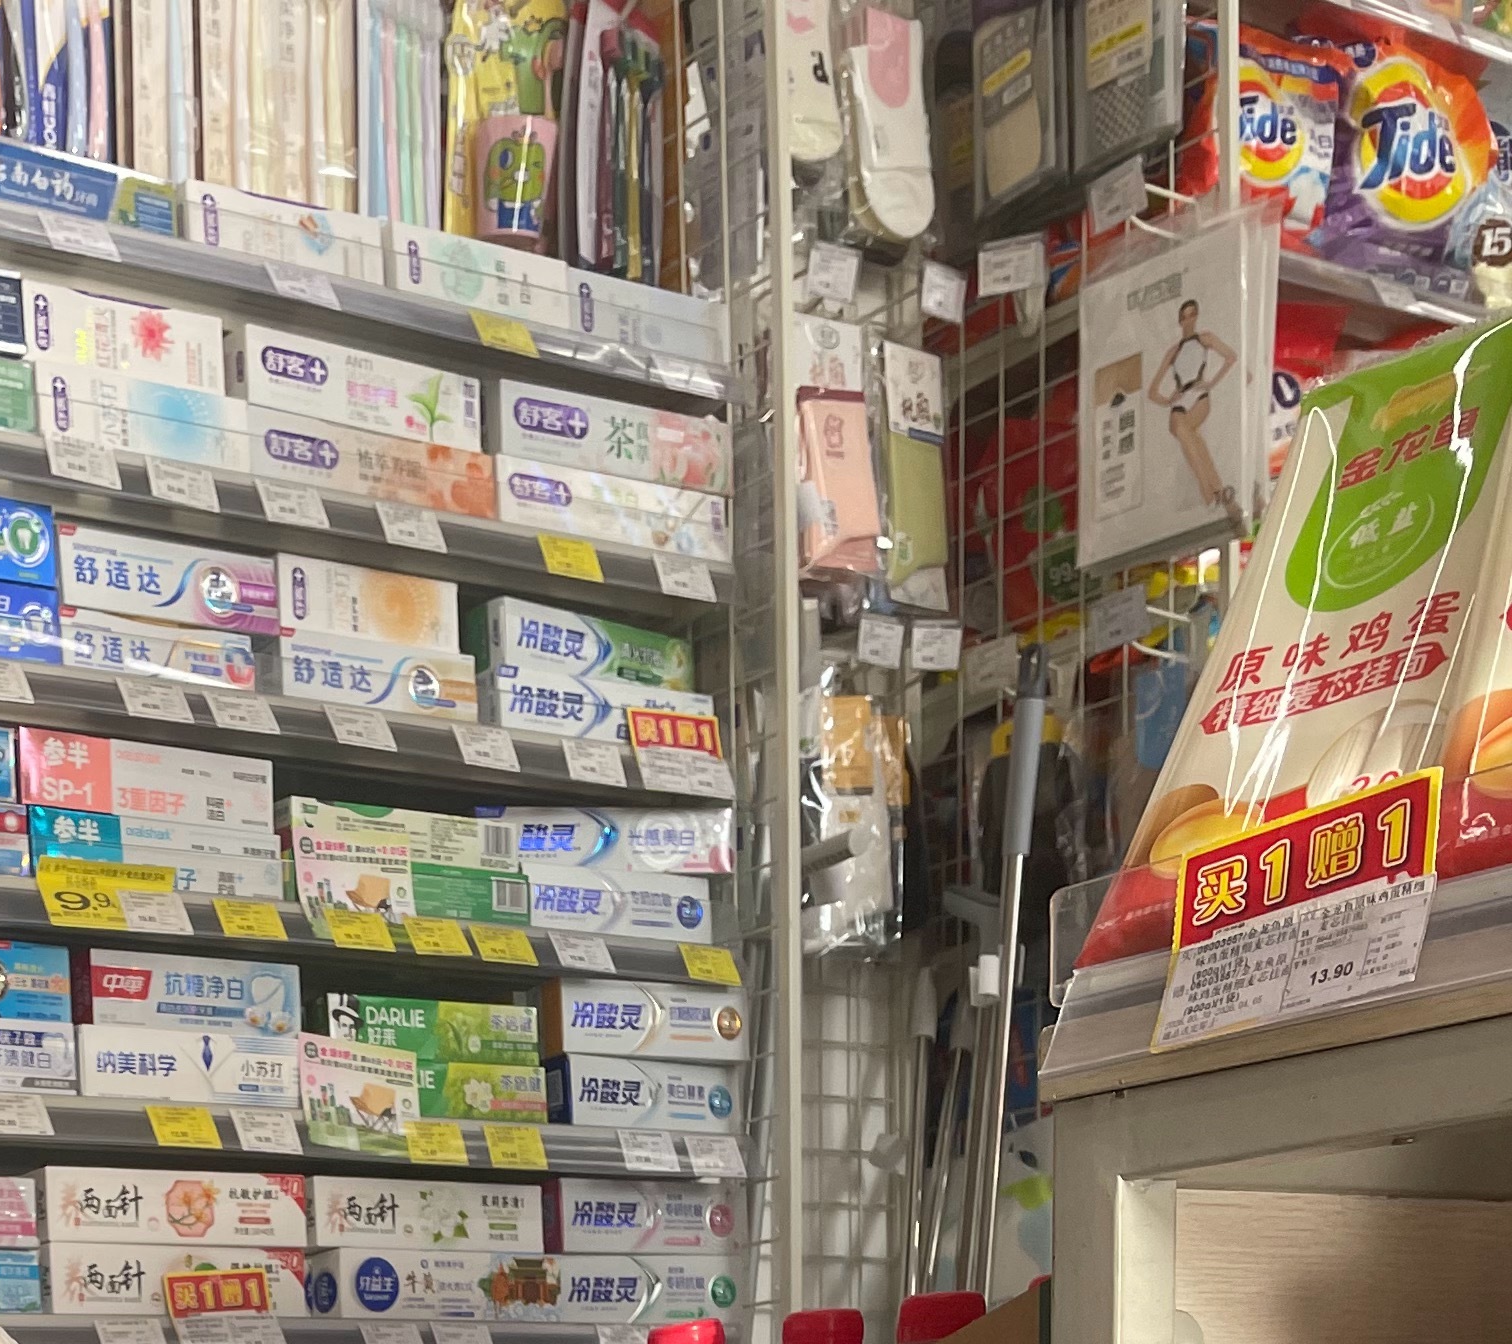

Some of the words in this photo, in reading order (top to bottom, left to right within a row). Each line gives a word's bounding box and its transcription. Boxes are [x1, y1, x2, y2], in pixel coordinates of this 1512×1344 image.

[1359, 103, 1459, 190] Tide
[604, 416, 635, 461] 茶
[1337, 406, 1480, 491] 金龙鱼
[74, 554, 162, 597] 舒适达
[74, 631, 152, 664] 舒适达
[517, 617, 587, 662] 冷酸灵
[1216, 591, 1462, 693] 原味鸡蛋
[293, 654, 372, 695] 舒适达
[509, 683, 585, 723] 冷酸灵
[1210, 648, 1429, 734] 精细麦芯挂面
[42, 737, 91, 769] 参半
[41, 780, 96, 808] SP-1
[116, 785, 186, 815] 3重因子
[53, 814, 101, 844] 参半
[1192, 799, 1411, 924] 买1赠1
[534, 884, 603, 916] 冷酸灵
[1309, 961, 1354, 986] 13.90
[365, 1006, 426, 1029] DARLIE
[571, 1001, 644, 1030] 冷酸灵
[367, 1028, 397, 1047] 好来
[96, 1050, 178, 1077] 纳美科学
[241, 1061, 284, 1079] 小苏打
[578, 1076, 642, 1105] 冷酸灵
[79, 1184, 144, 1224] 两面针
[572, 1201, 637, 1228] 冷酸灵
[86, 1259, 146, 1300] 两面针
[568, 1275, 641, 1302] 冷酸灵
